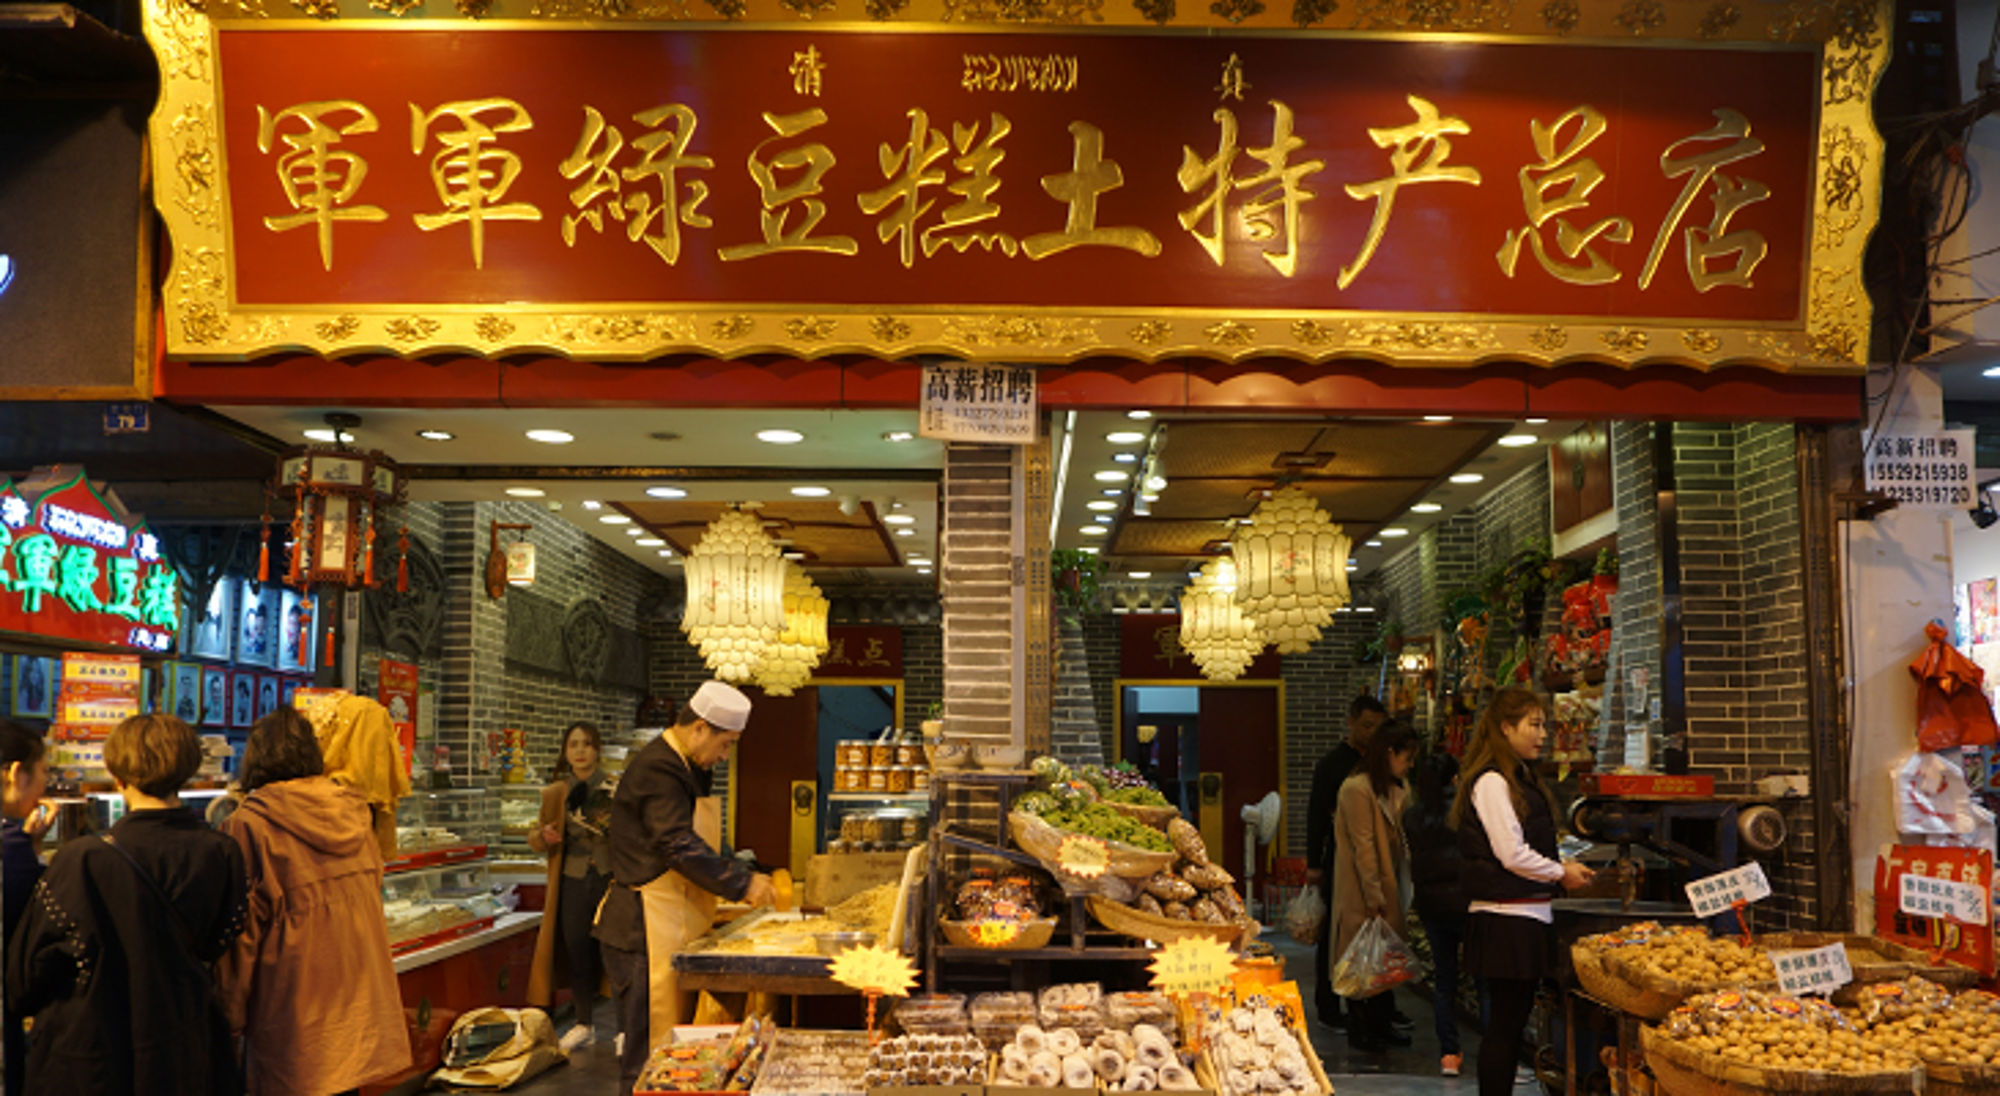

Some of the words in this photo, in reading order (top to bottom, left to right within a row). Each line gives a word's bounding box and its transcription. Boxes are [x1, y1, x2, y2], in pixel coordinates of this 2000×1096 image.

[788, 44, 828, 97] 清
[1213, 51, 1253, 102] 真
[927, 366, 1033, 404] 高薪招聘
[1871, 487, 1970, 504] 229319720
